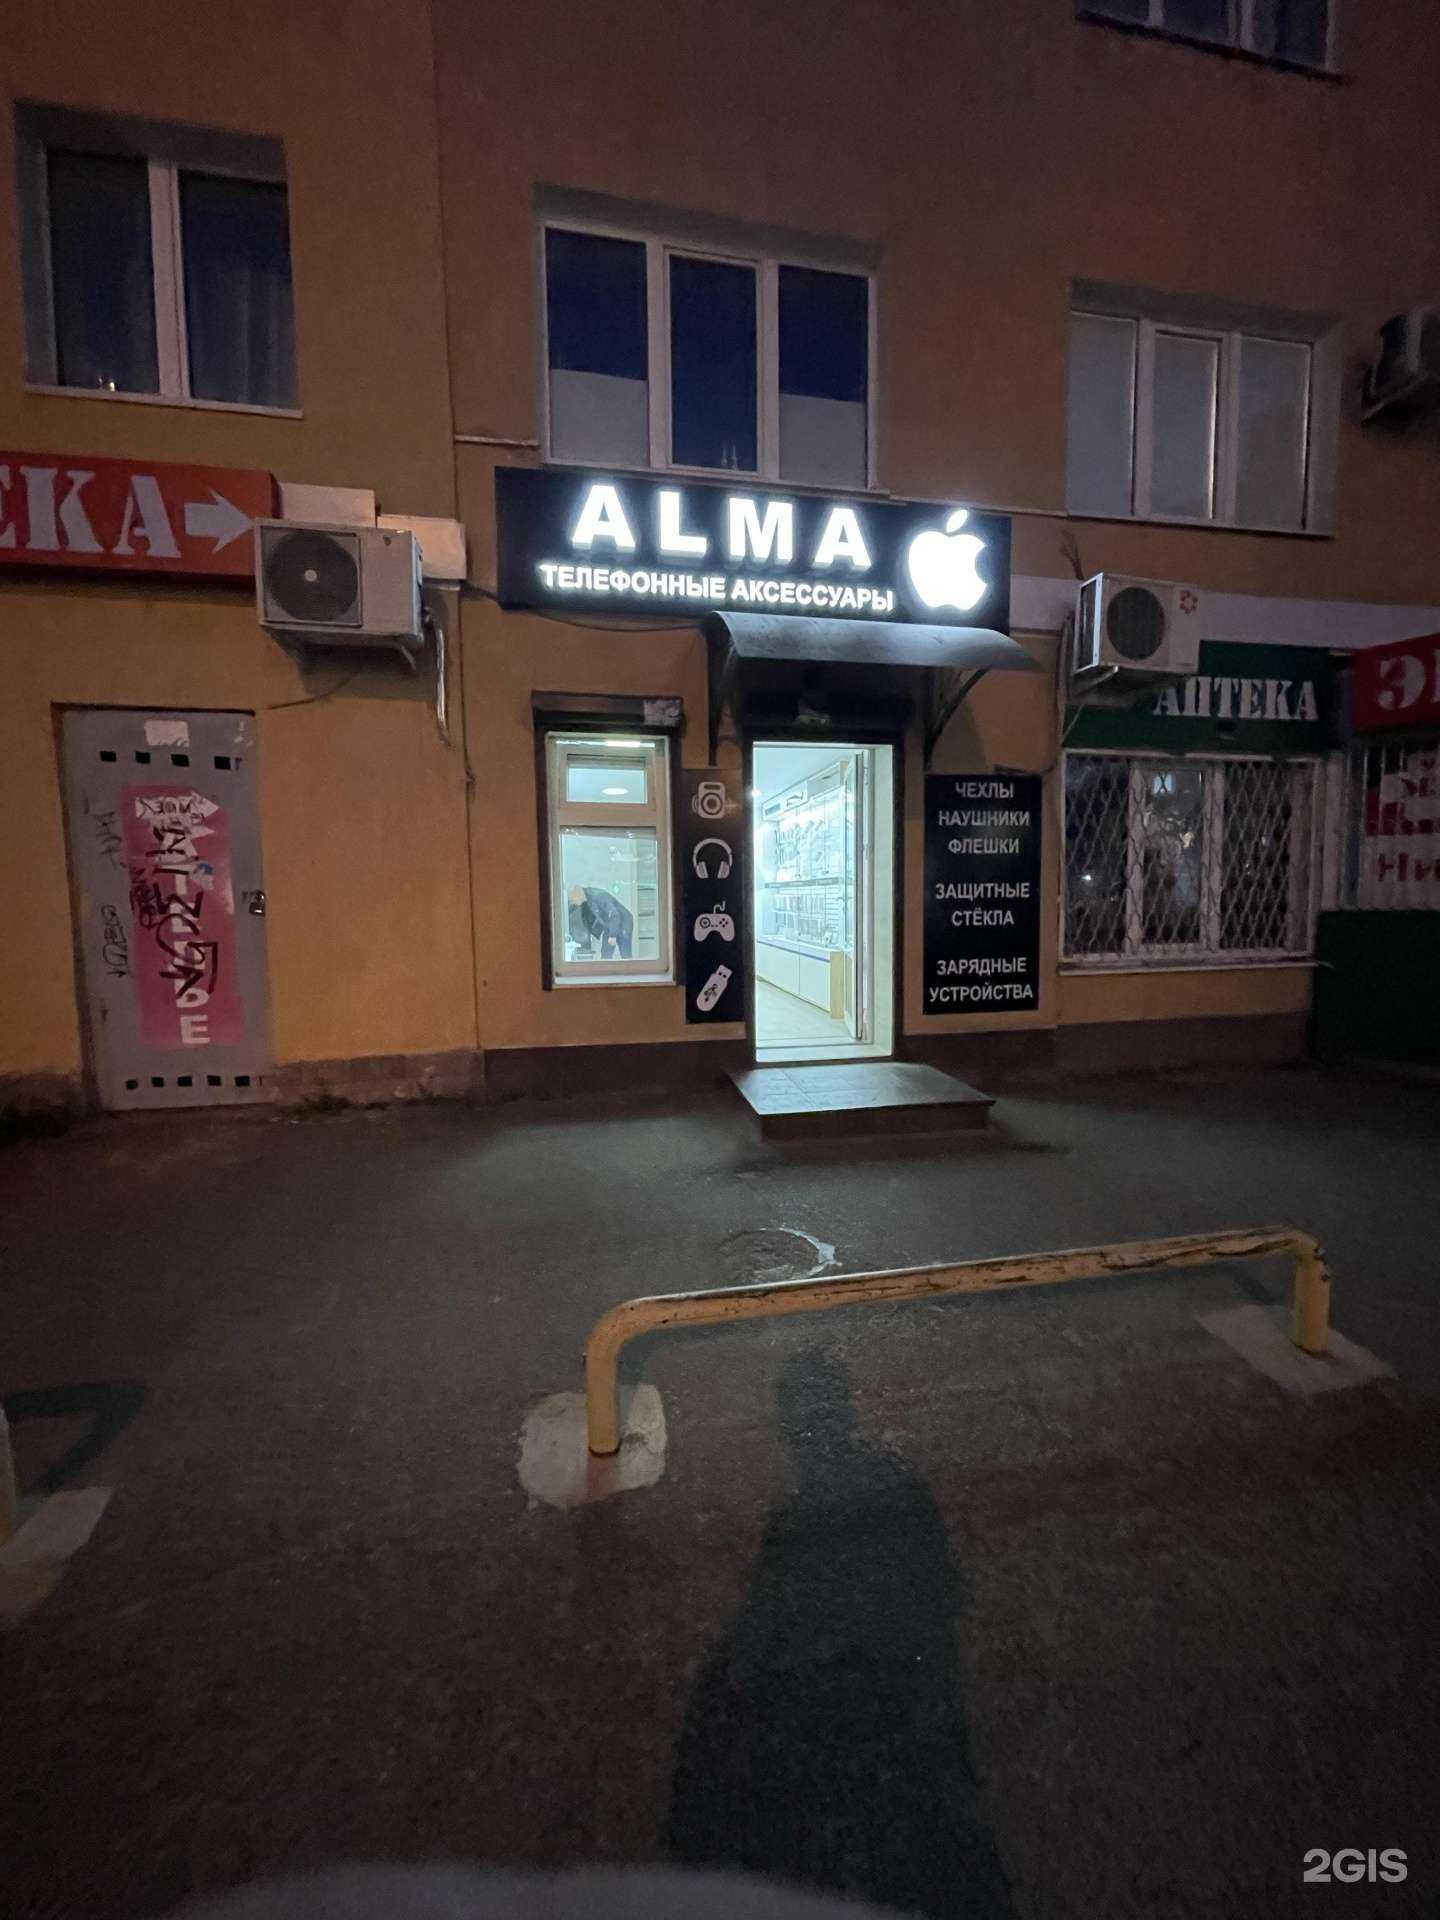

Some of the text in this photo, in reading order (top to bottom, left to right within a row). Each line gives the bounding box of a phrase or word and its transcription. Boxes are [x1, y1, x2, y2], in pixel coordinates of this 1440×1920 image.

[0, 465, 182, 559] КА
[571, 484, 873, 571] ALMA
[540, 563, 894, 610] ТЕЛЕФОННЫЕ АКСЕССУАРЫ
[1376, 649, 1440, 711] Э
[1152, 675, 1320, 721] АПТЕКА
[955, 782, 1014, 799] ЧЕХЛЫ
[938, 810, 1031, 827] НАУШНИКИ
[948, 838, 1020, 854] ФЛЕШКИ
[935, 882, 1030, 902] ЗАЩИТНЫЕ
[952, 907, 1015, 926] СТЁКЛА
[936, 957, 1027, 976] ЗАРЯДНЫЕ
[929, 982, 1033, 1002] УСТРОЙСТВА
